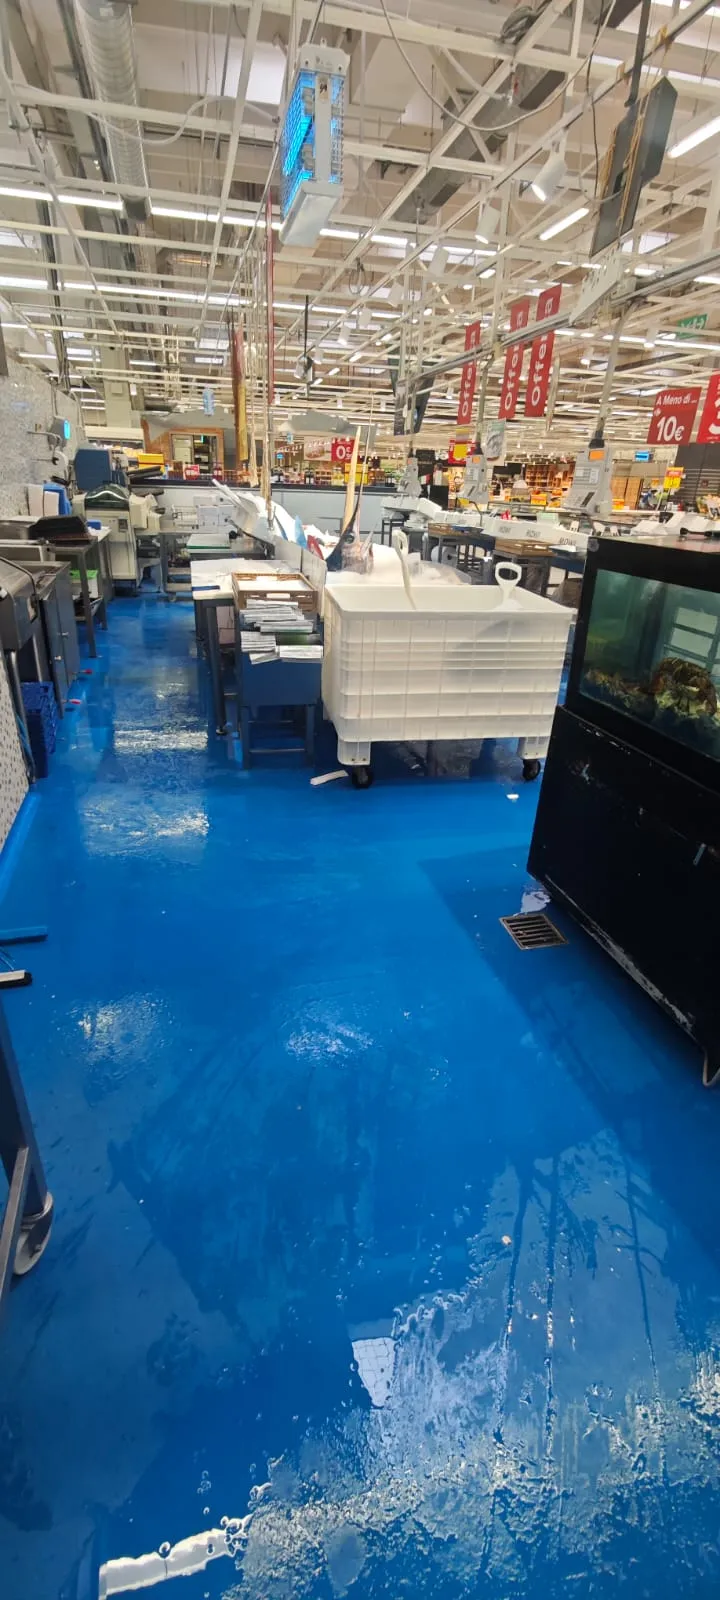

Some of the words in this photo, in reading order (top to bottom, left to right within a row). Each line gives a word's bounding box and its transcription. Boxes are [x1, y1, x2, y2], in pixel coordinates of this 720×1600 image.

[531, 297, 554, 406] Offera
[656, 395, 662, 406] A
[662, 394, 683, 406] Meno
[656, 415, 685, 442] 10€
